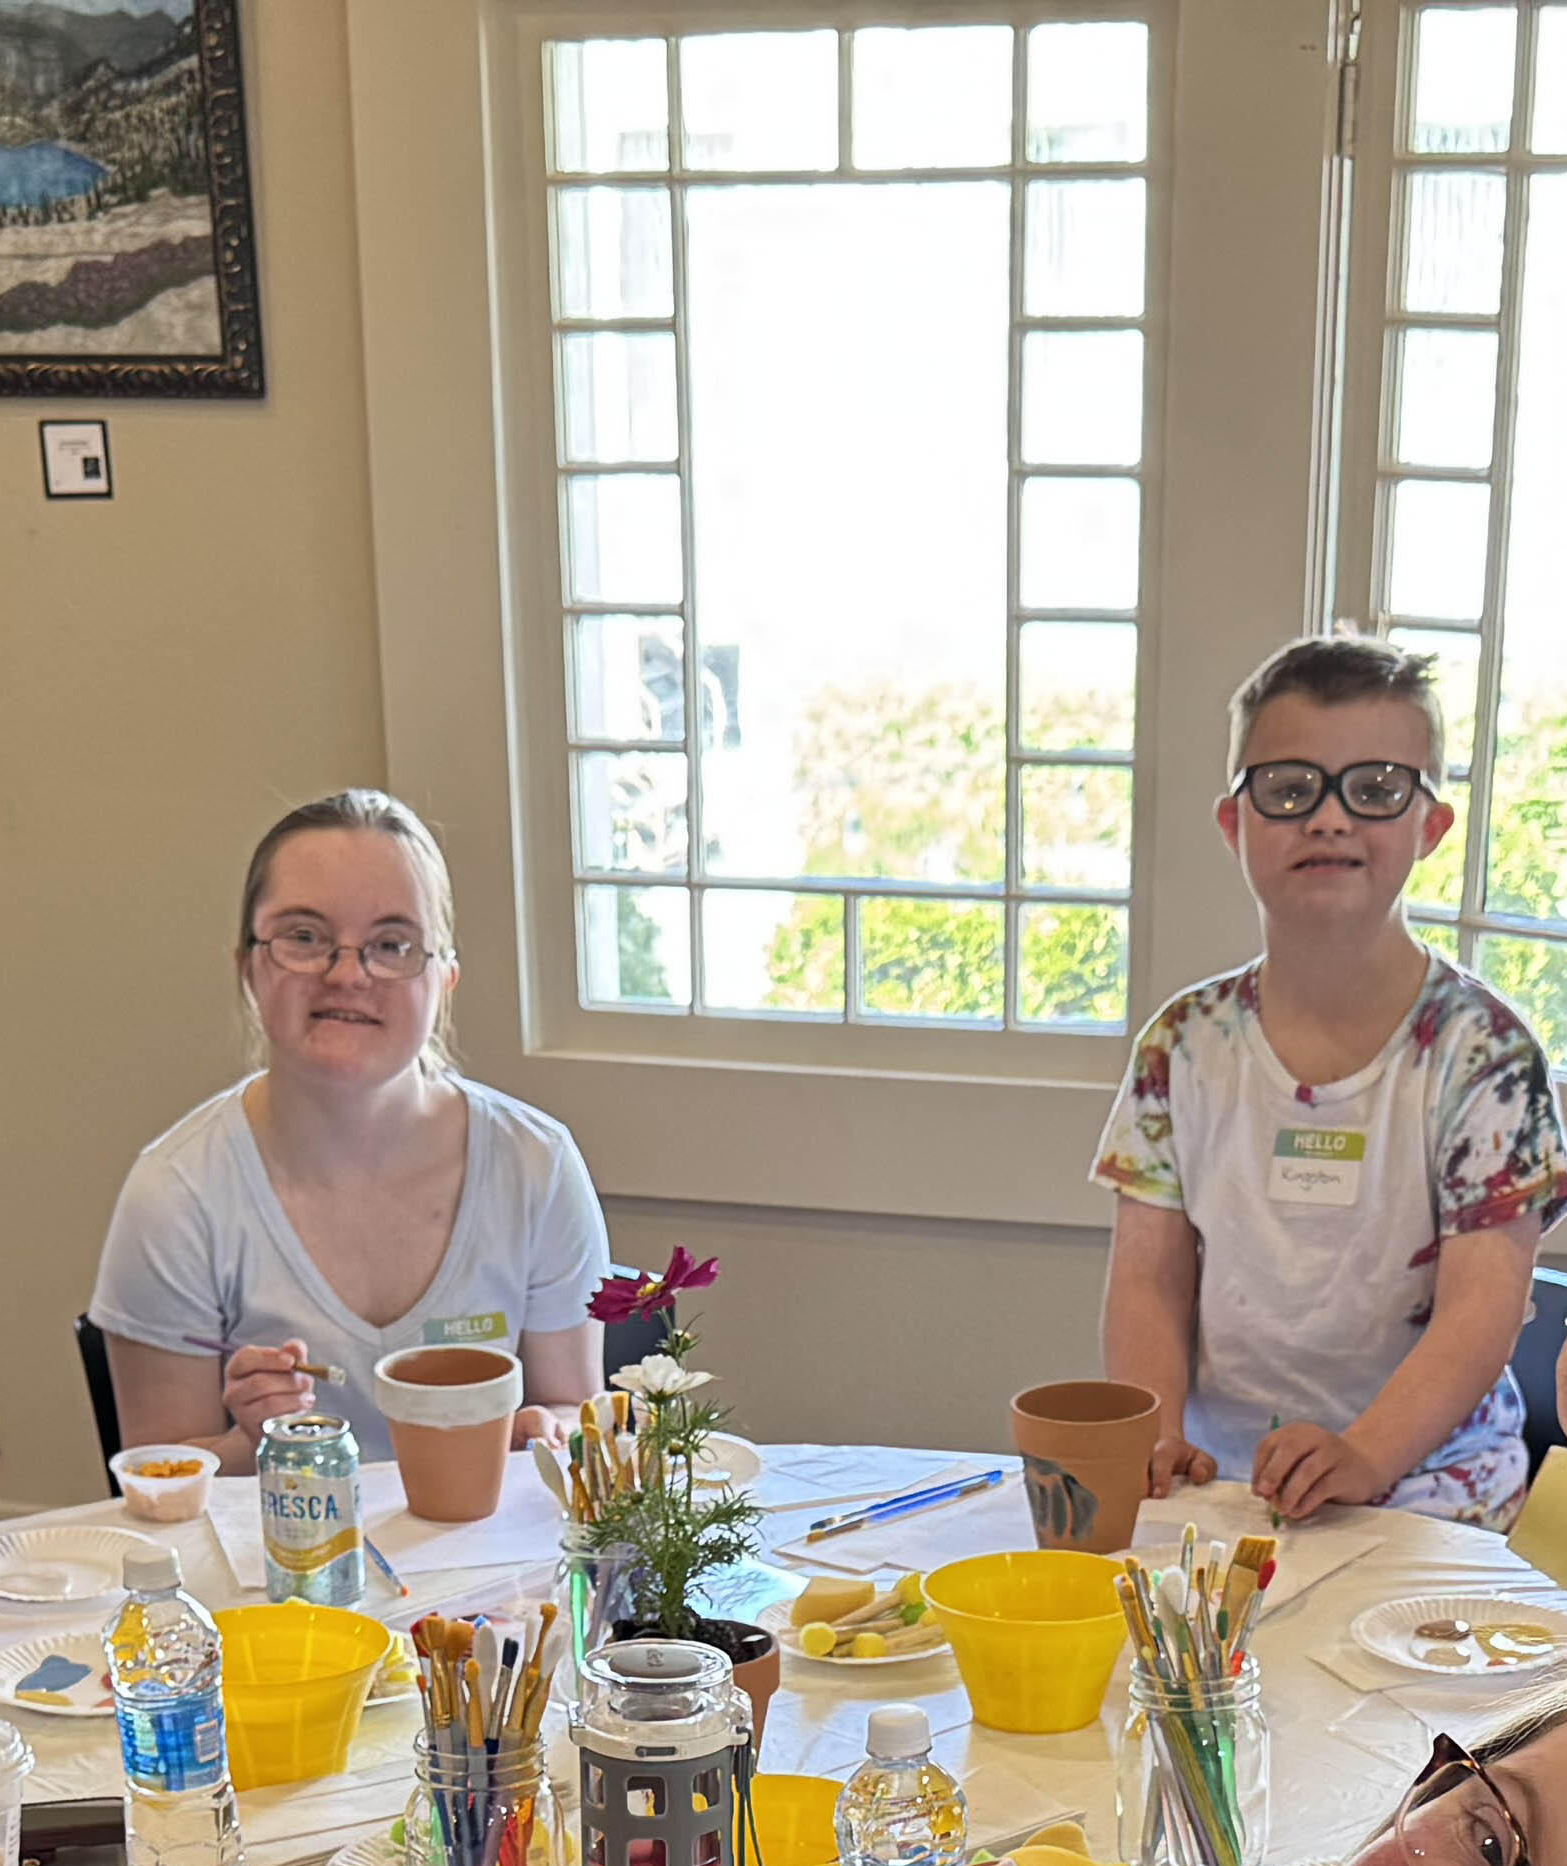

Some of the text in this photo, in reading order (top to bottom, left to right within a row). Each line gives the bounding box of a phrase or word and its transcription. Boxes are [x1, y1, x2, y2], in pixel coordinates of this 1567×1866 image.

[1294, 1132, 1347, 1151] HELLO
[443, 1317, 493, 1336] HELLO
[260, 1488, 338, 1520] FRESCA
